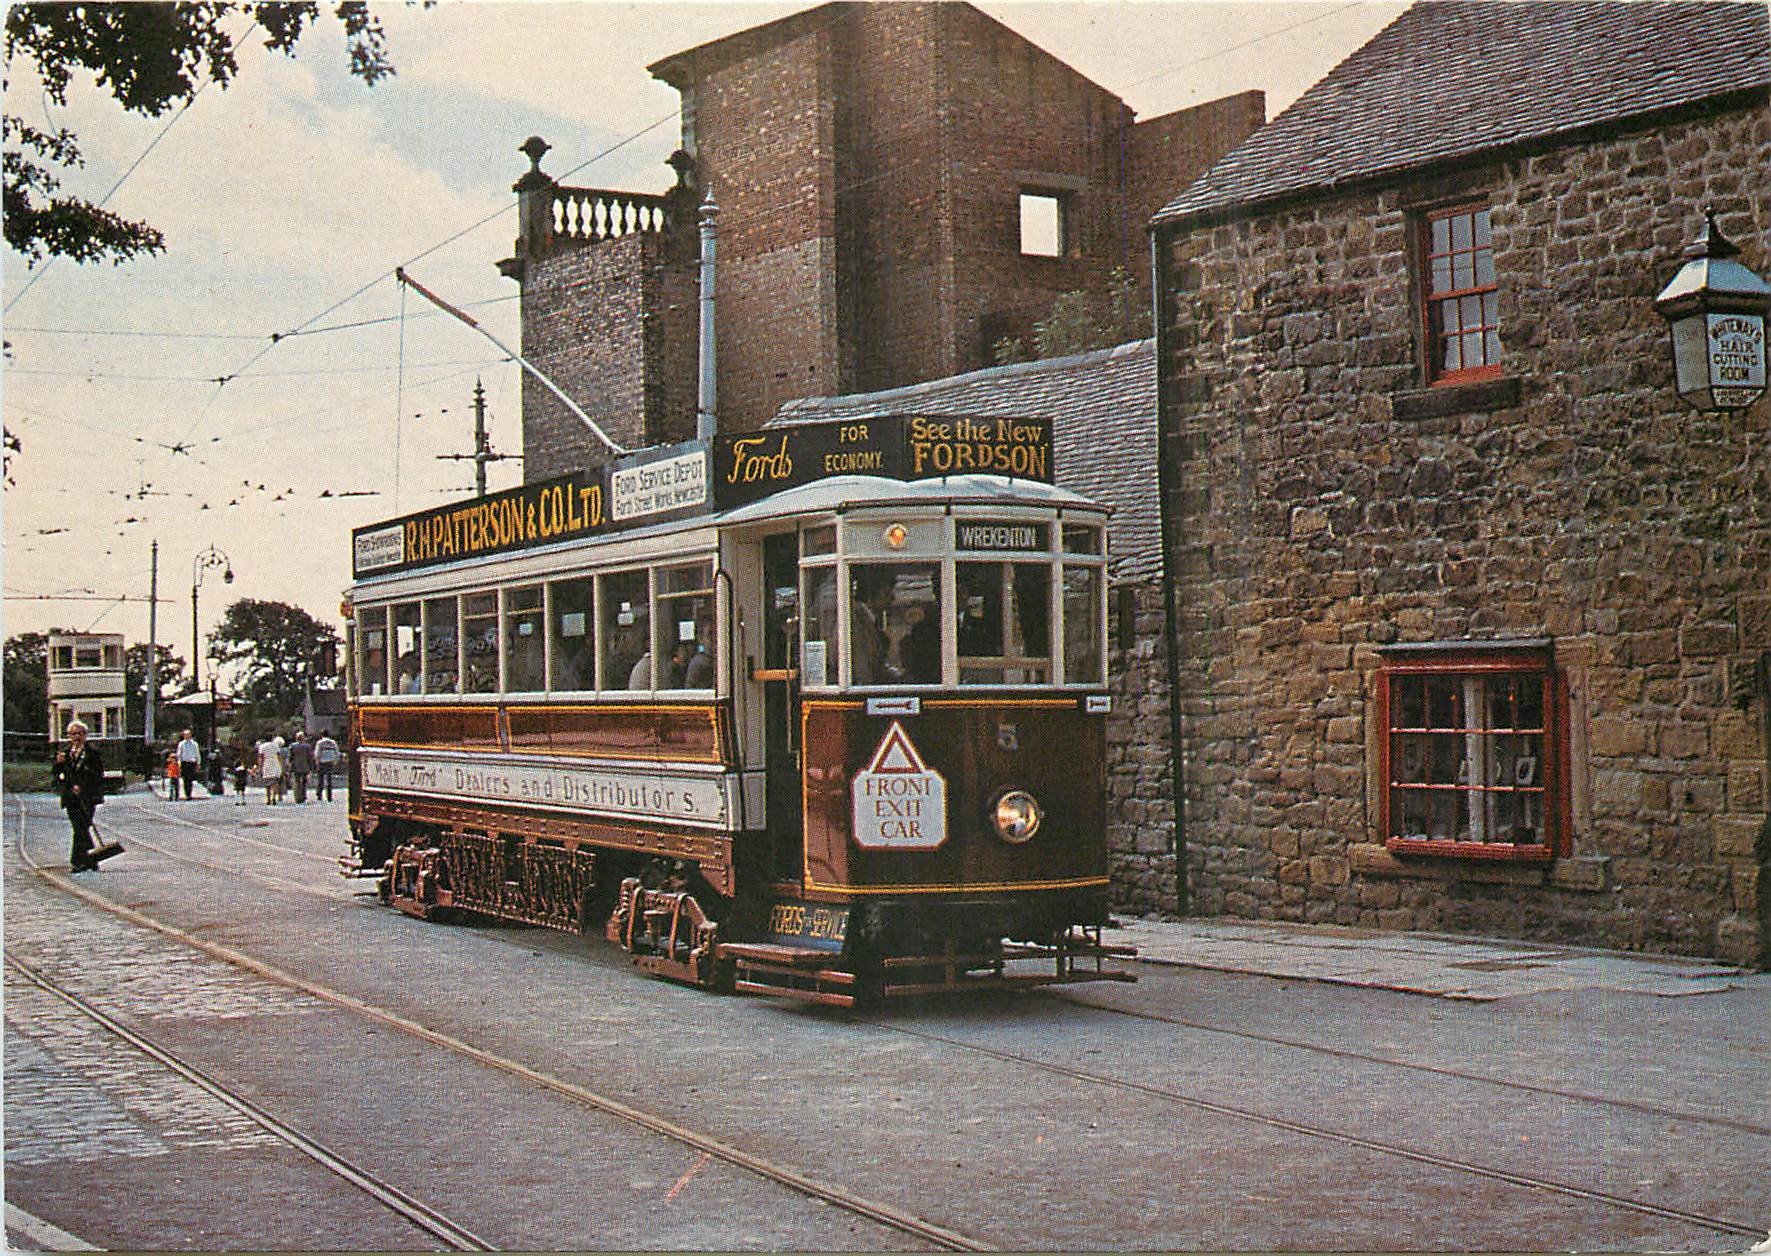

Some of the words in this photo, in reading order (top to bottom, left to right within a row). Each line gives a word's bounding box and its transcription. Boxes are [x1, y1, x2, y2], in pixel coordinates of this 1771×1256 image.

[1720, 339, 1754, 354] HAIR
[1712, 353, 1758, 366] CUTTING
[1718, 366, 1749, 380] ROOM
[839, 424, 869, 444] FOR
[911, 417, 951, 440] See
[956, 418, 991, 441] the
[997, 419, 1042, 442] New
[727, 435, 793, 484] Fords
[615, 474, 636, 497] FORD
[639, 466, 671, 492] SERVICE
[674, 459, 703, 484] DEPOT
[961, 526, 1037, 548] WREKENTON
[374, 762, 400, 784] Main
[455, 767, 511, 794] Dealers
[520, 778, 553, 799] and
[864, 778, 932, 797] FRONT
[875, 799, 921, 817] EXIT
[880, 820, 923, 839] CAR
